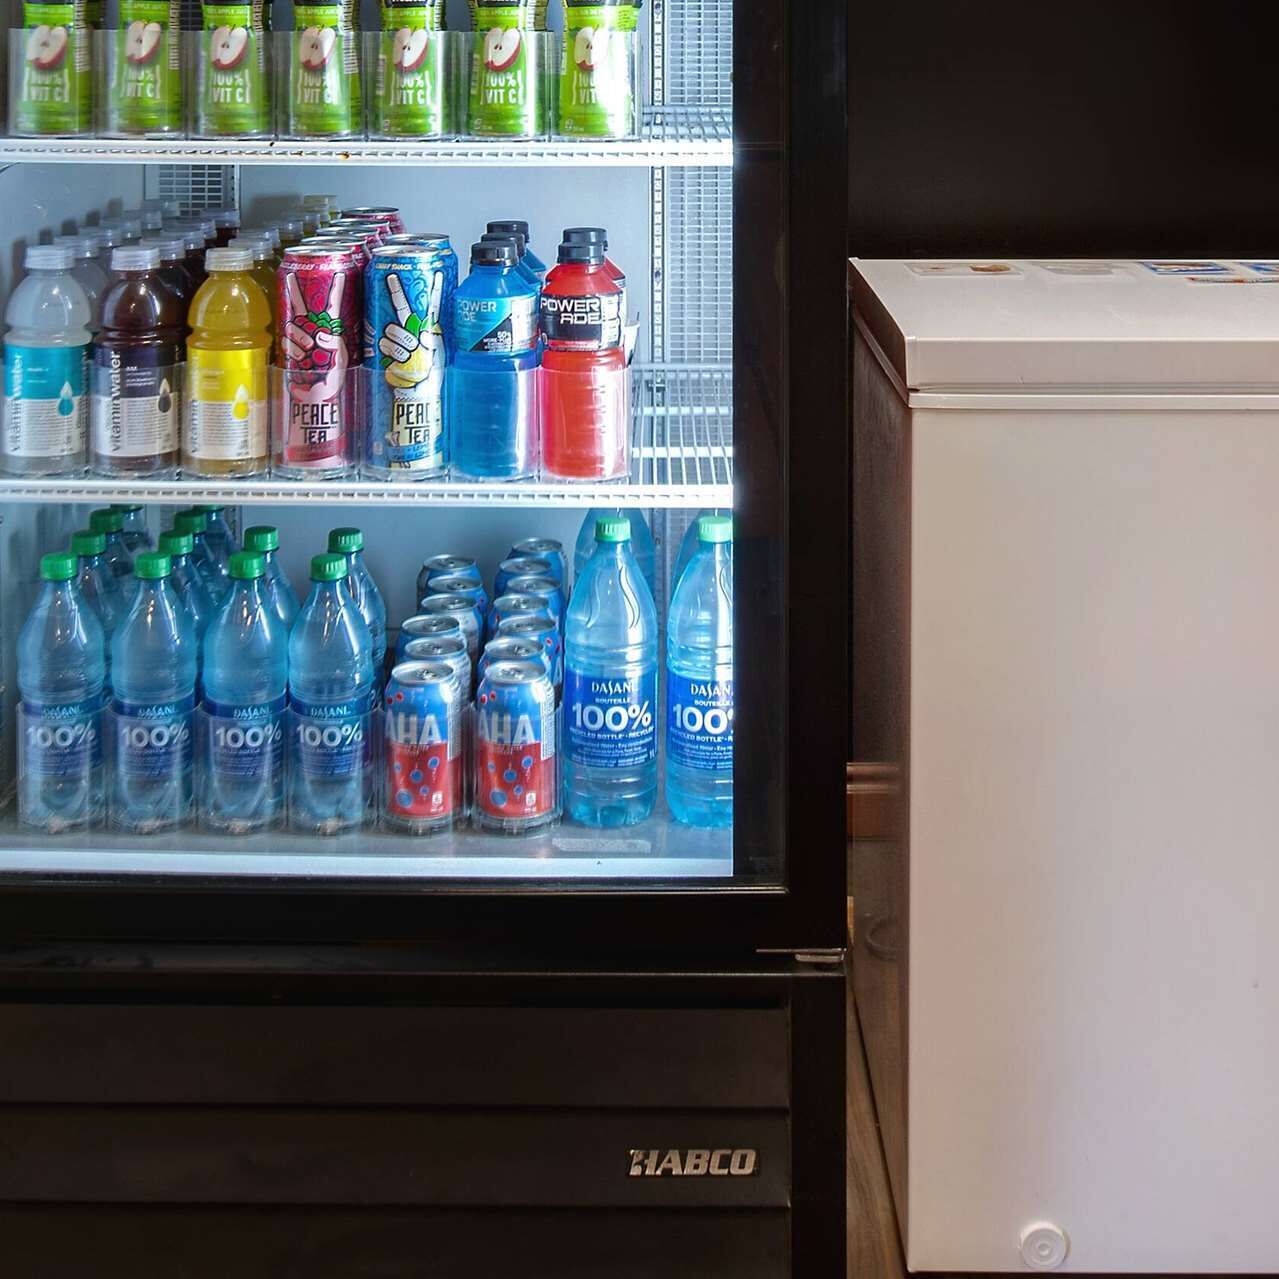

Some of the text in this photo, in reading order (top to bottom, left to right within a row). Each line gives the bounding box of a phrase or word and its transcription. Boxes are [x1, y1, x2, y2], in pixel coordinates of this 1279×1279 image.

[540, 298, 600, 312] POWER
[560, 313, 602, 325] ADE
[111, 350, 121, 452] vitaminwater
[293, 403, 338, 424] PEACE
[396, 402, 440, 425] PEACE
[300, 426, 327, 443] TEA
[406, 426, 431, 444] TEA
[387, 712, 441, 744] AHA
[480, 712, 535, 744] AHA
[572, 700, 652, 732] 100%
[26, 721, 95, 748] 100%
[121, 721, 189, 748] 100%
[215, 722, 282, 748] 100%
[296, 721, 363, 748] 100%
[629, 1149, 756, 1175] HABCO
